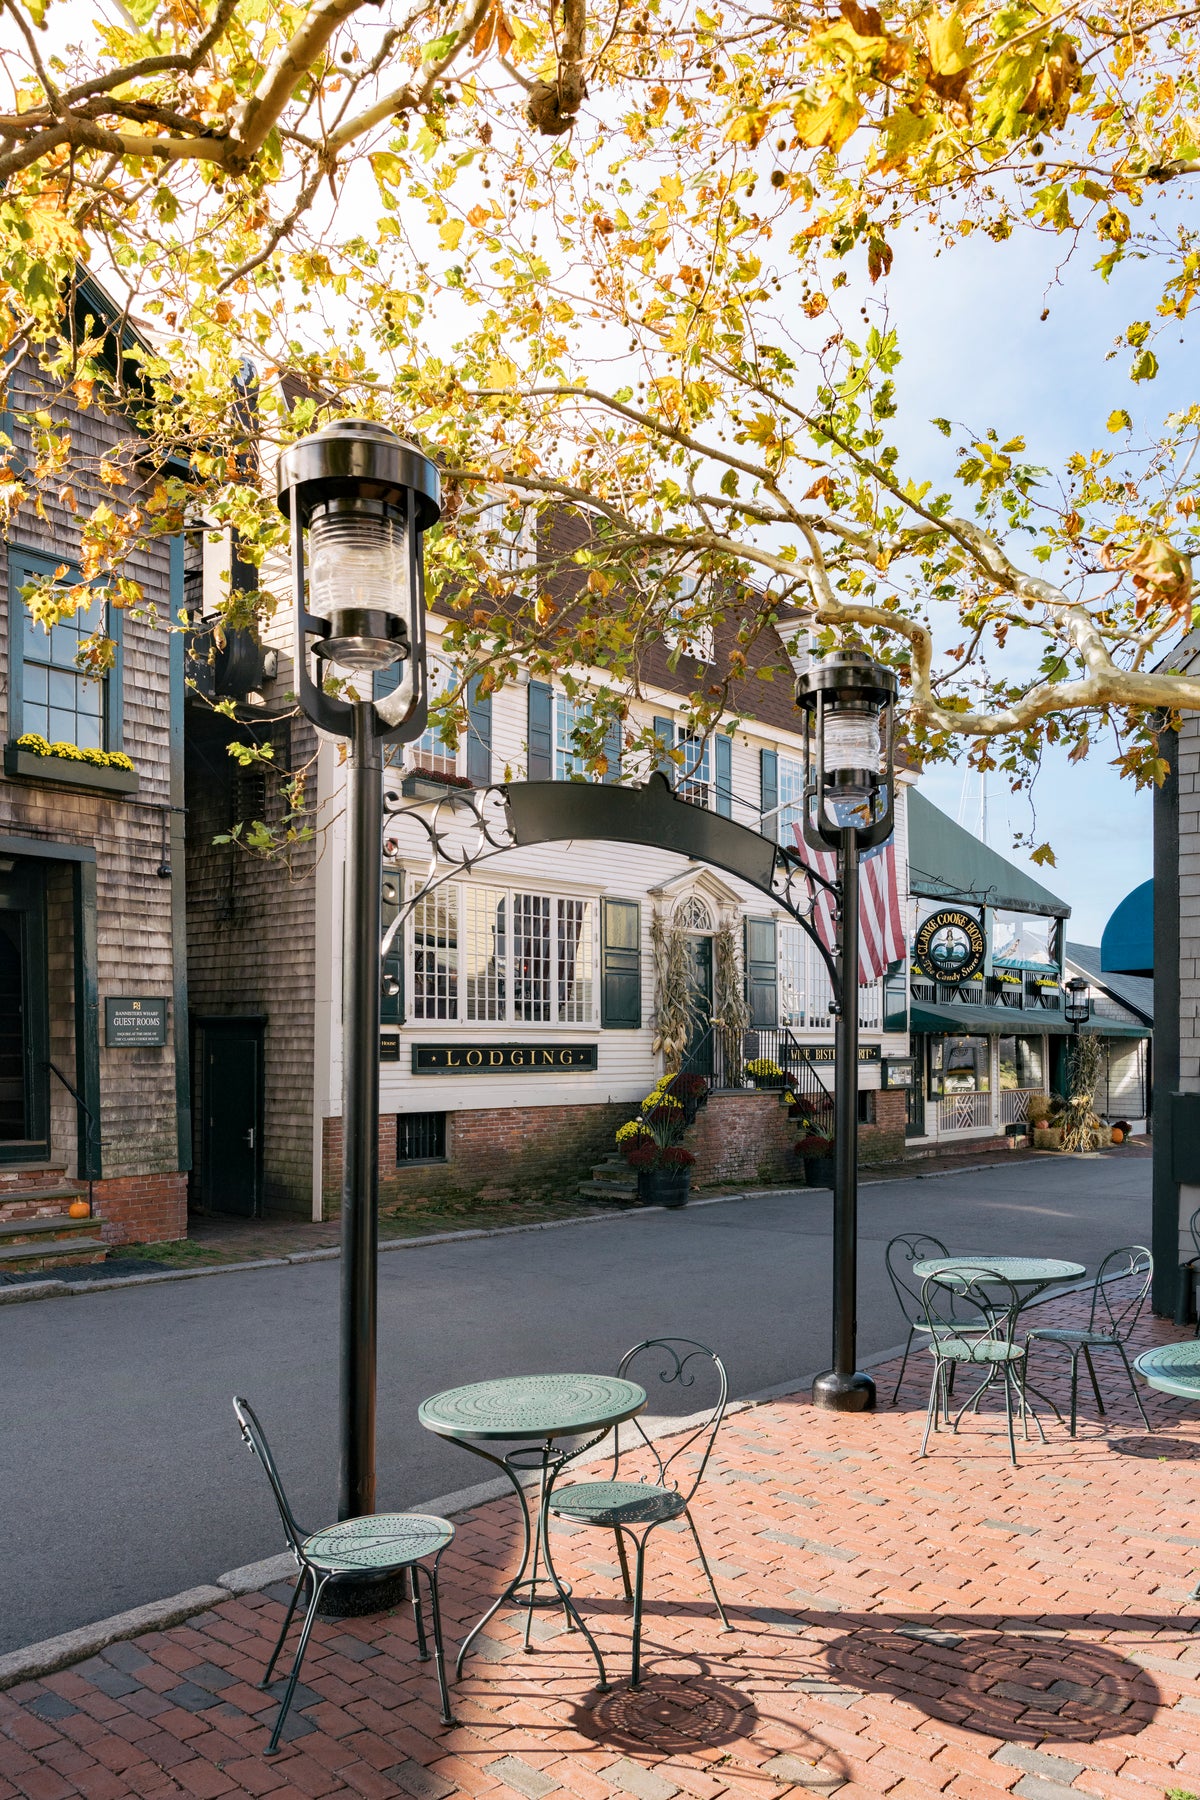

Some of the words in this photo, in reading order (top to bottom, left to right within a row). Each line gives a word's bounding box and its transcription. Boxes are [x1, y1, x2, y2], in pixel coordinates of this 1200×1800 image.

[918, 919, 938, 954] CLARKE
[937, 913, 968, 927] COOKE
[965, 922, 982, 952] HOUSE
[923, 959, 935, 975] The
[935, 970, 961, 981] Candy
[961, 958, 979, 977] Store
[114, 1018, 135, 1026] GUEST
[136, 1018, 160, 1026] ROOMS
[446, 1050, 573, 1066] LODGING
